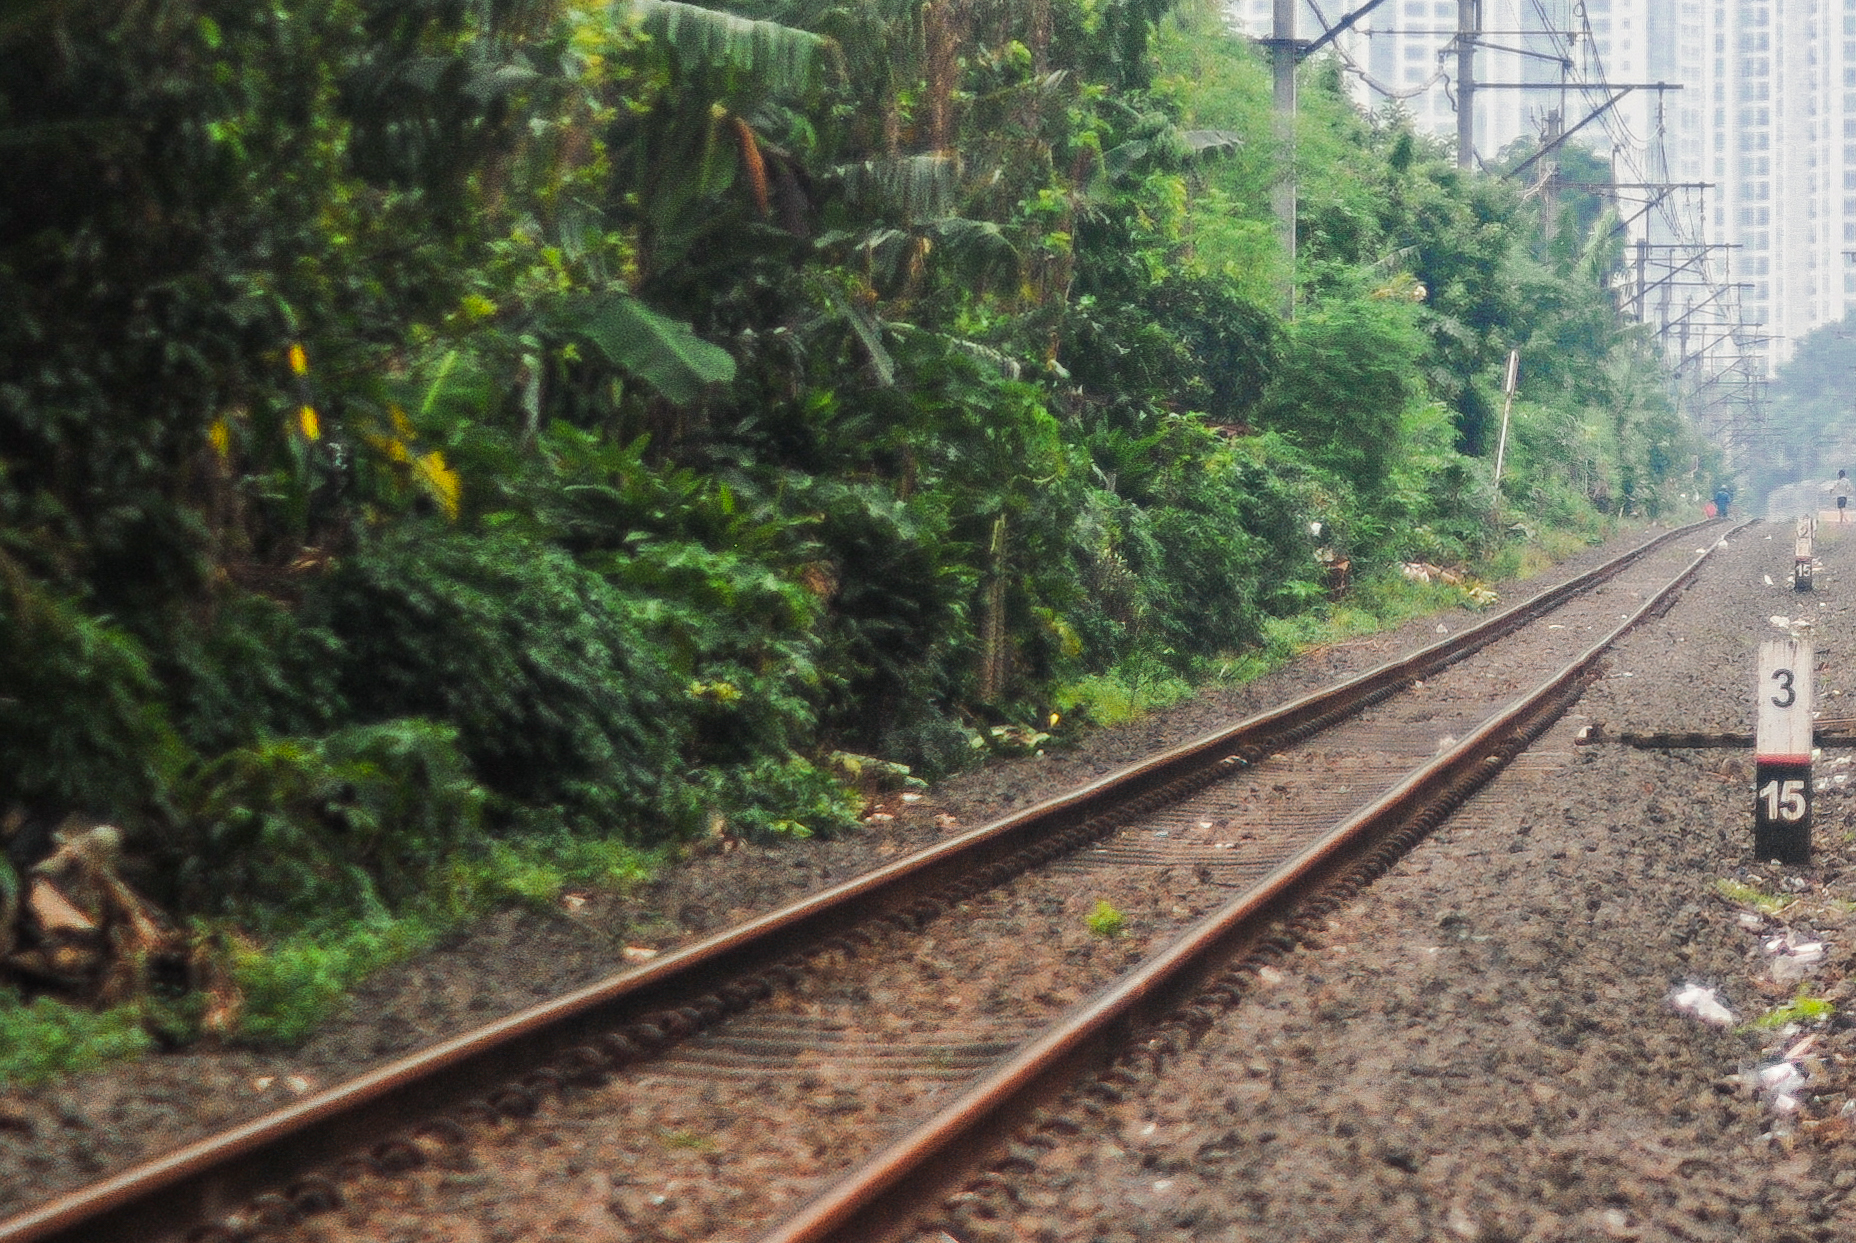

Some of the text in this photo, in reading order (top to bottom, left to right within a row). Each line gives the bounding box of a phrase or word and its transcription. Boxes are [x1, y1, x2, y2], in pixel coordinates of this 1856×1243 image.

[1795, 563, 1811, 577] 15
[1770, 668, 1796, 708] 3
[1759, 779, 1806, 821] 15
